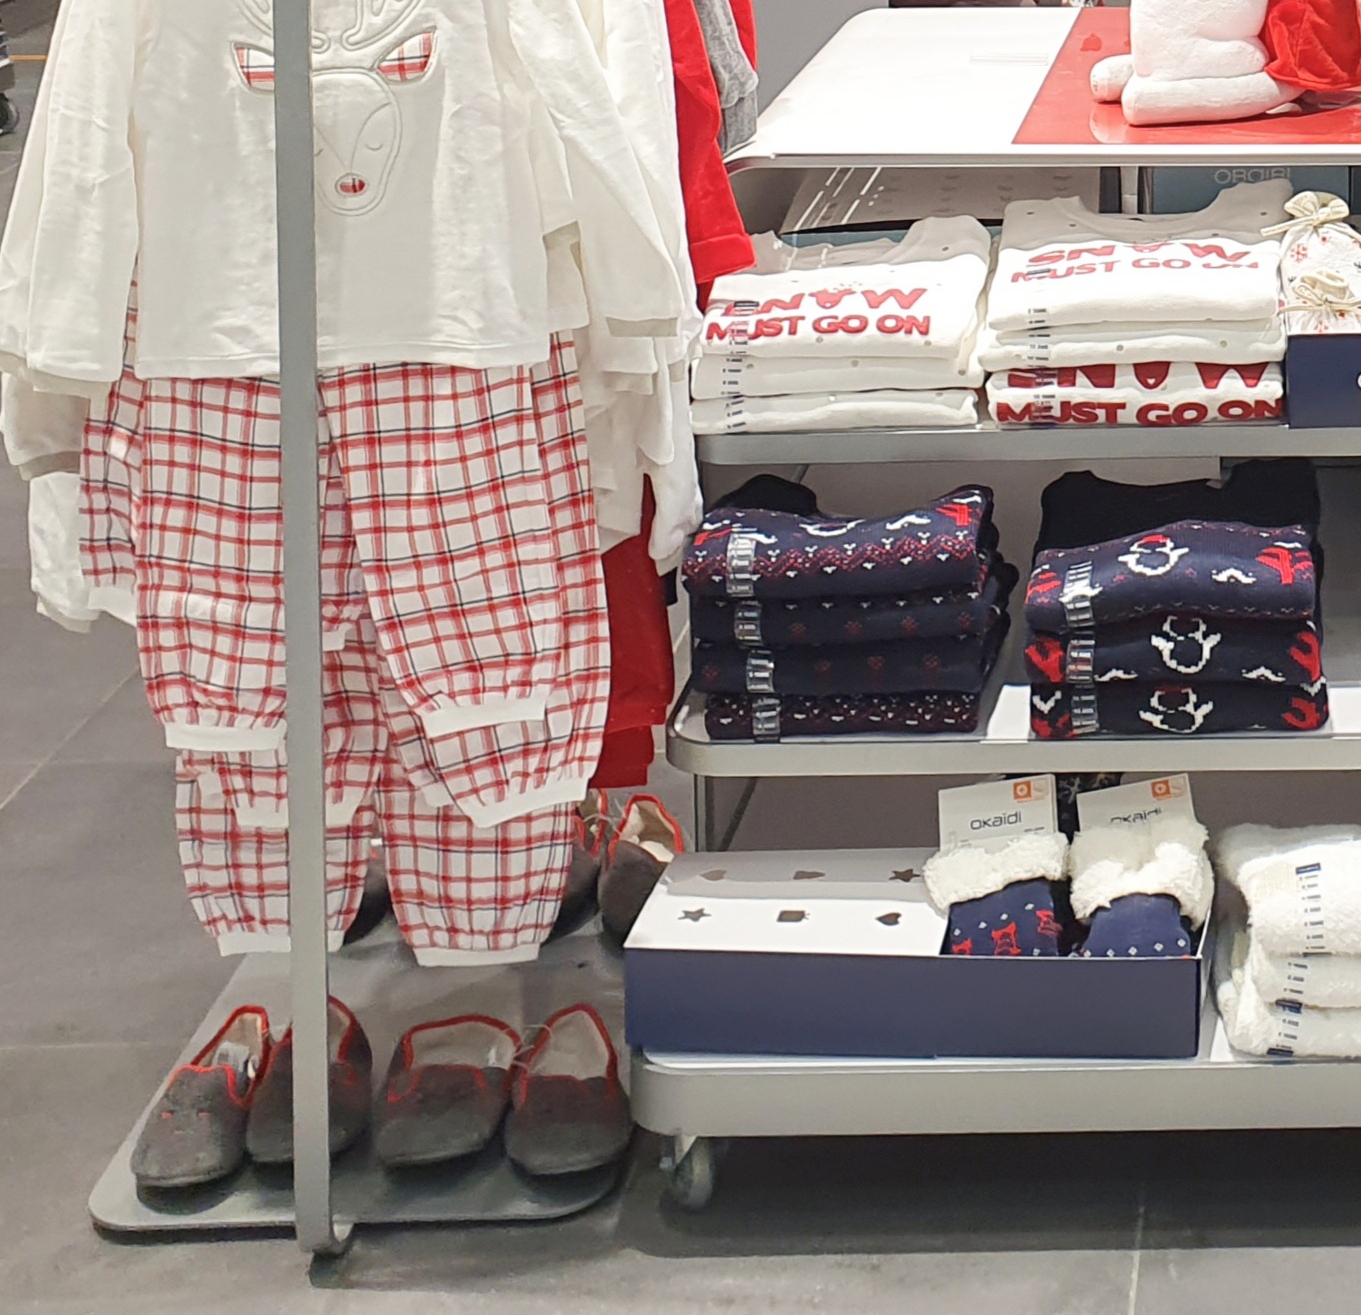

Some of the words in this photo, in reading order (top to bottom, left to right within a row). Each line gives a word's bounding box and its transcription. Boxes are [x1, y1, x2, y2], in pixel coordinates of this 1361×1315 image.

[1131, 258, 1192, 269] GO
[812, 314, 869, 335] GO
[876, 314, 931, 336] ON
[1135, 402, 1209, 426] GO
[1217, 397, 1284, 421] ON
